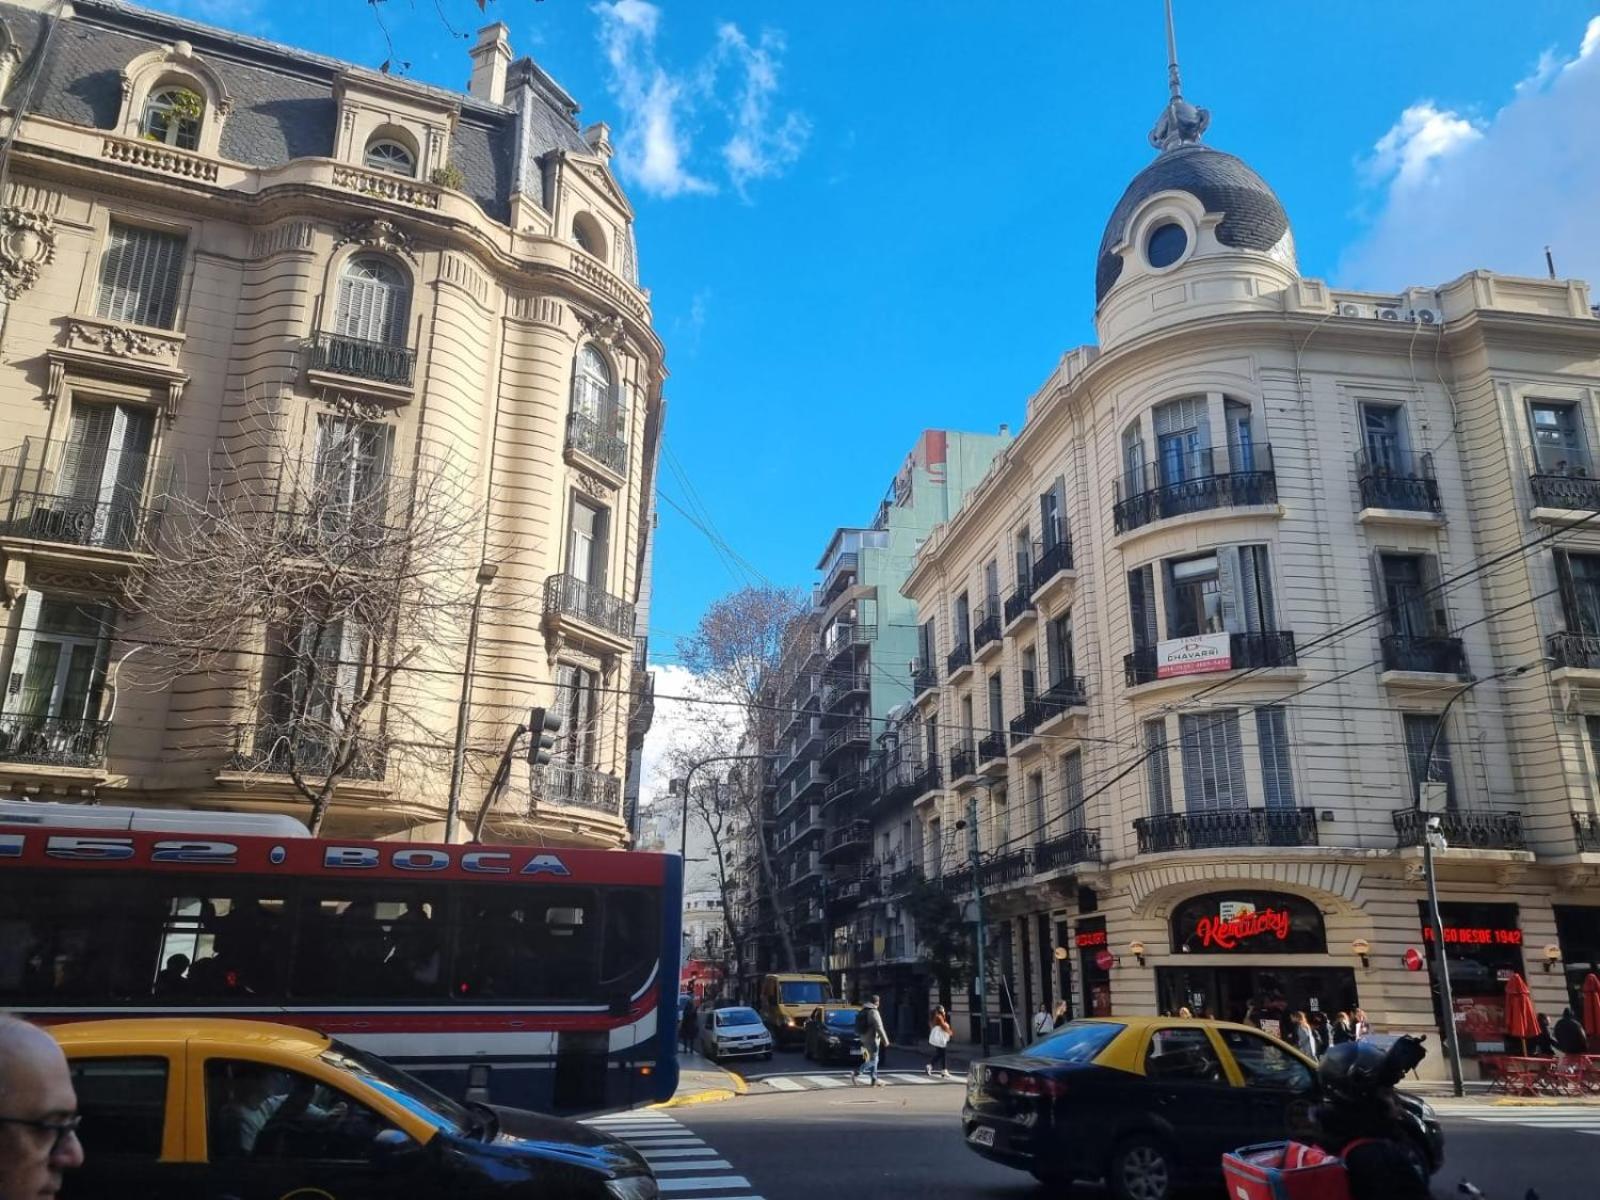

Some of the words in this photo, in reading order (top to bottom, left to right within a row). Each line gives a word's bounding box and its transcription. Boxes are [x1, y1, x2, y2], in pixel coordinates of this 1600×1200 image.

[324, 846, 571, 876] BOCA
[1197, 908, 1288, 948] Kentucky
[1424, 927, 1458, 943] FGO
[1460, 928, 1492, 944] DESDE
[1494, 930, 1521, 944] 1942
